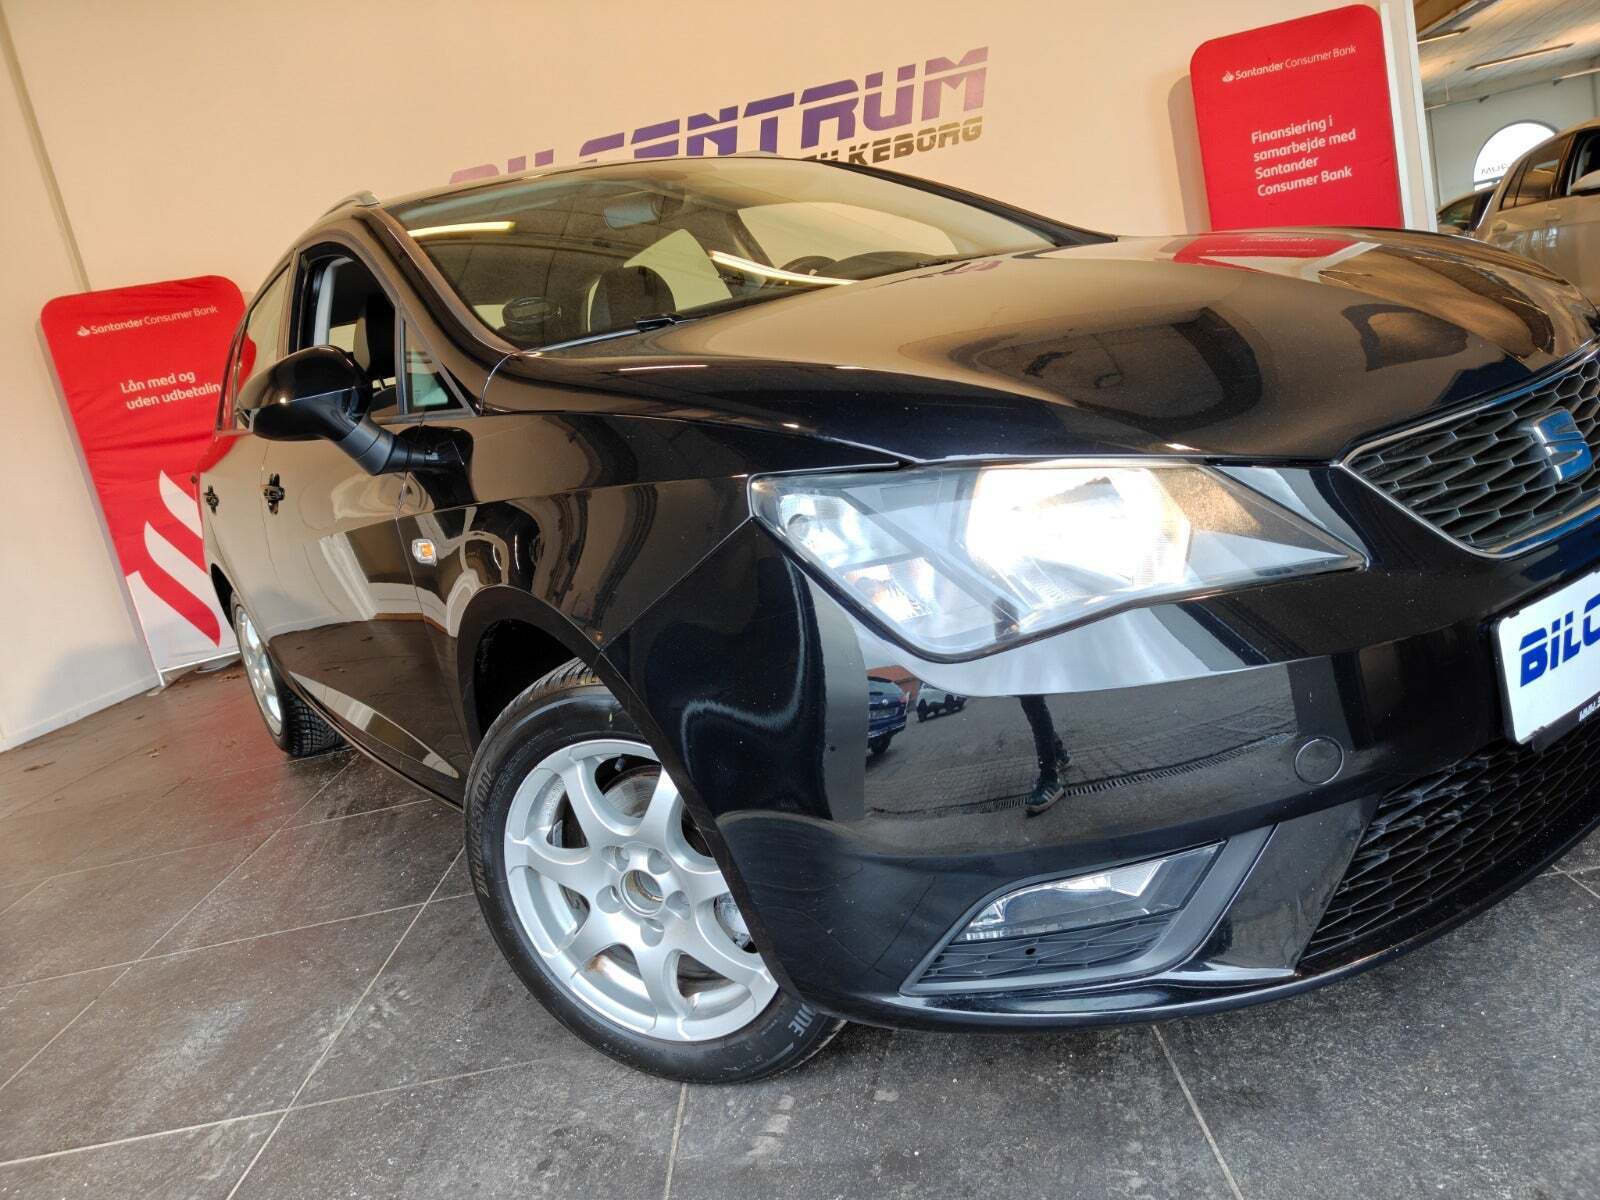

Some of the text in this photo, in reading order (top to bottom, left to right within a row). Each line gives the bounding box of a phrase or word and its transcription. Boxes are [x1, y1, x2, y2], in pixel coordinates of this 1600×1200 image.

[1235, 45, 1357, 80] Santander Consumer Bank
[801, 116, 983, 165] KEBORG
[1251, 114, 1333, 145] Finansiering i
[1253, 128, 1357, 162] samarbejde med
[1255, 157, 1319, 180] Santander
[1257, 165, 1353, 197] Consumer Bank
[90, 304, 218, 335] Santander Consumer Bank
[120, 371, 196, 394] Lån med og
[126, 395, 160, 410] uden
